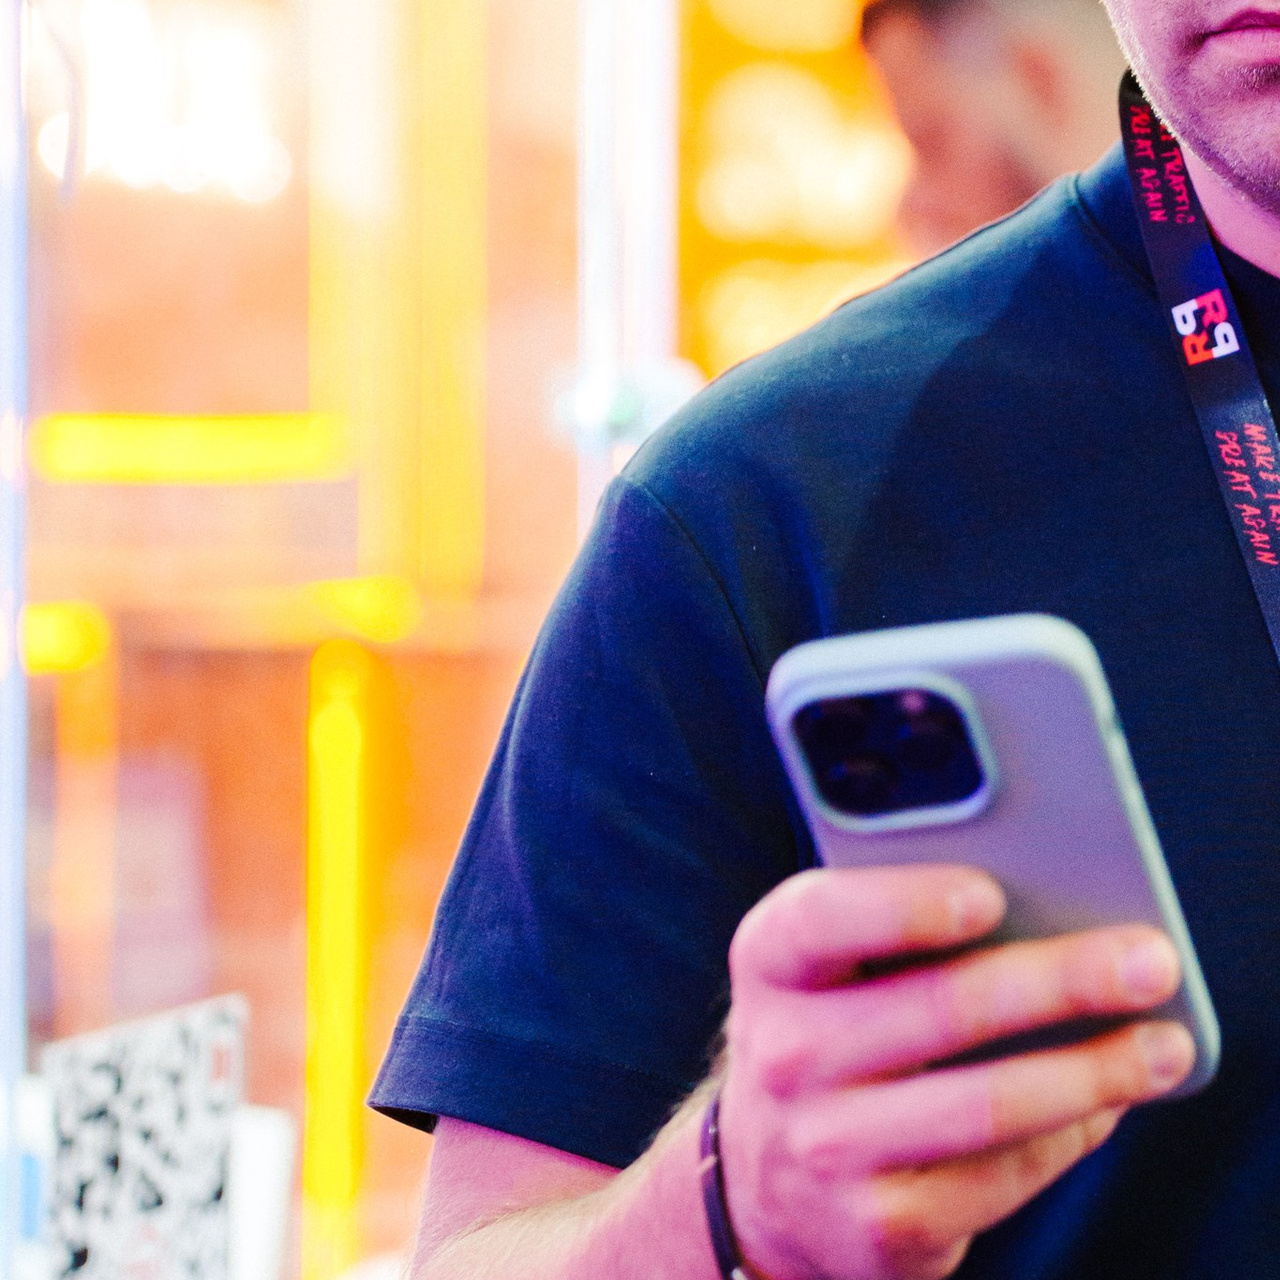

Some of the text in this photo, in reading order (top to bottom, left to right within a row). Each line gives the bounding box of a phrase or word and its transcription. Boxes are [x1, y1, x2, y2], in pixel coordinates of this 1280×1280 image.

[1136, 168, 1168, 222] AGAIN
[1215, 430, 1279, 566] GREAT AGAIN
